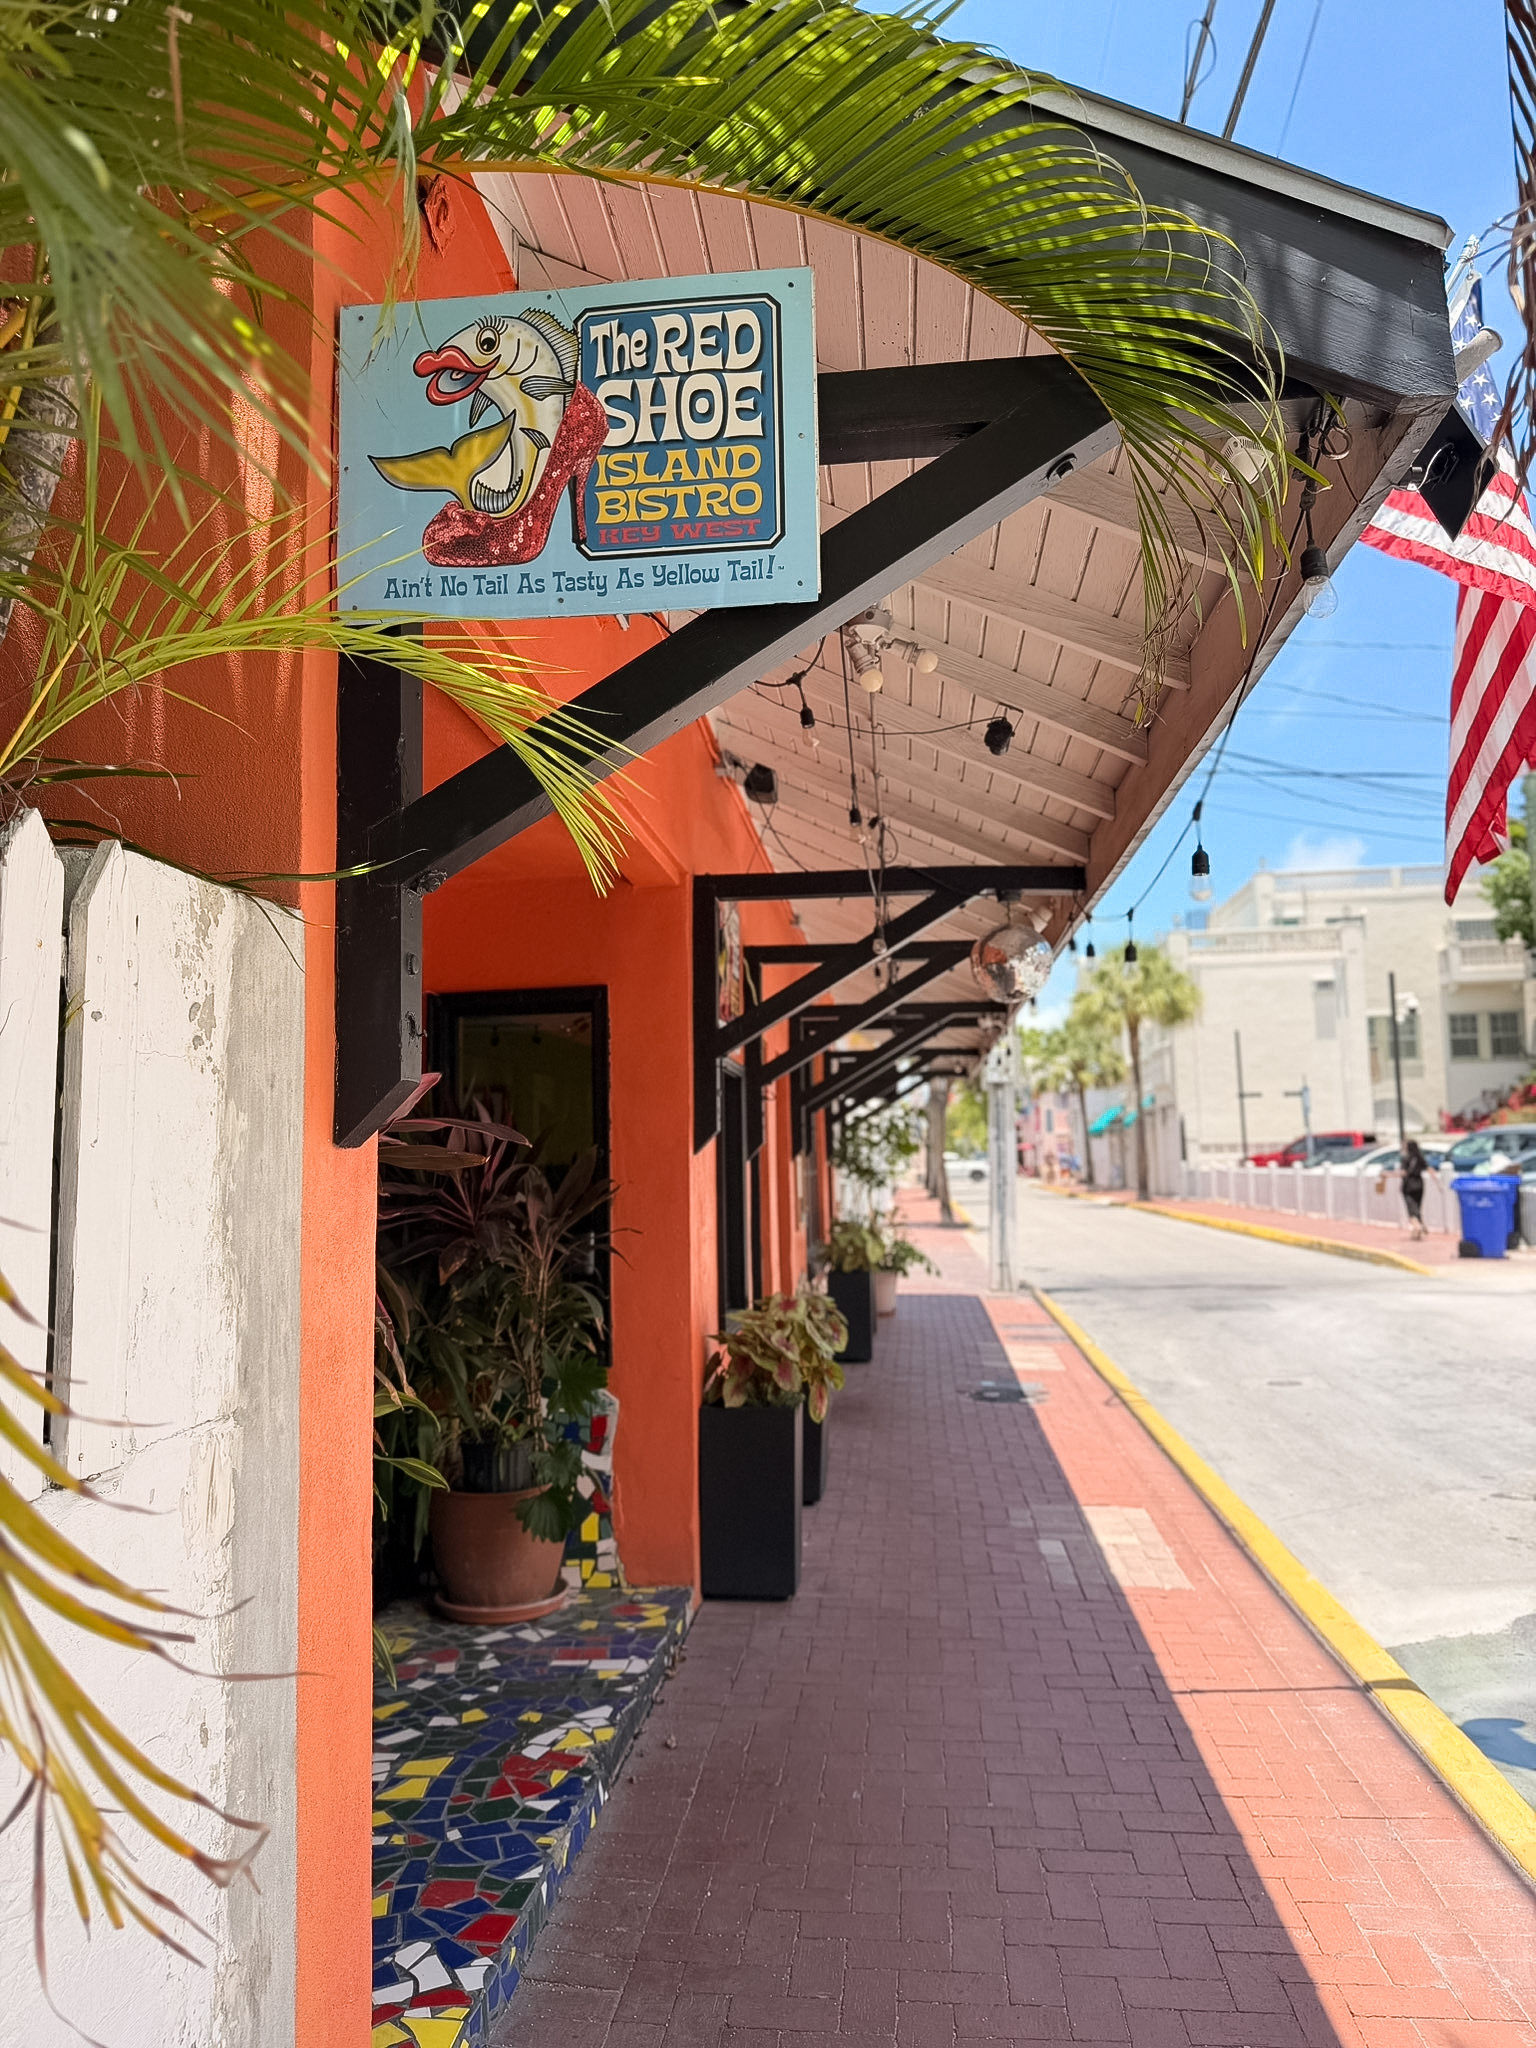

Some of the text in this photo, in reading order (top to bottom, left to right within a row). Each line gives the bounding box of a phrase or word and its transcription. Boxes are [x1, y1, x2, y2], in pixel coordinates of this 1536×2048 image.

[589, 309, 762, 378] The RED
[596, 370, 764, 447] SHOE
[595, 445, 762, 487] ISLAND
[595, 481, 763, 524] BISTRO
[599, 519, 761, 545] KEY WEST
[384, 554, 776, 599] Ain't No Tail As Tasty As Yellow Tail!
